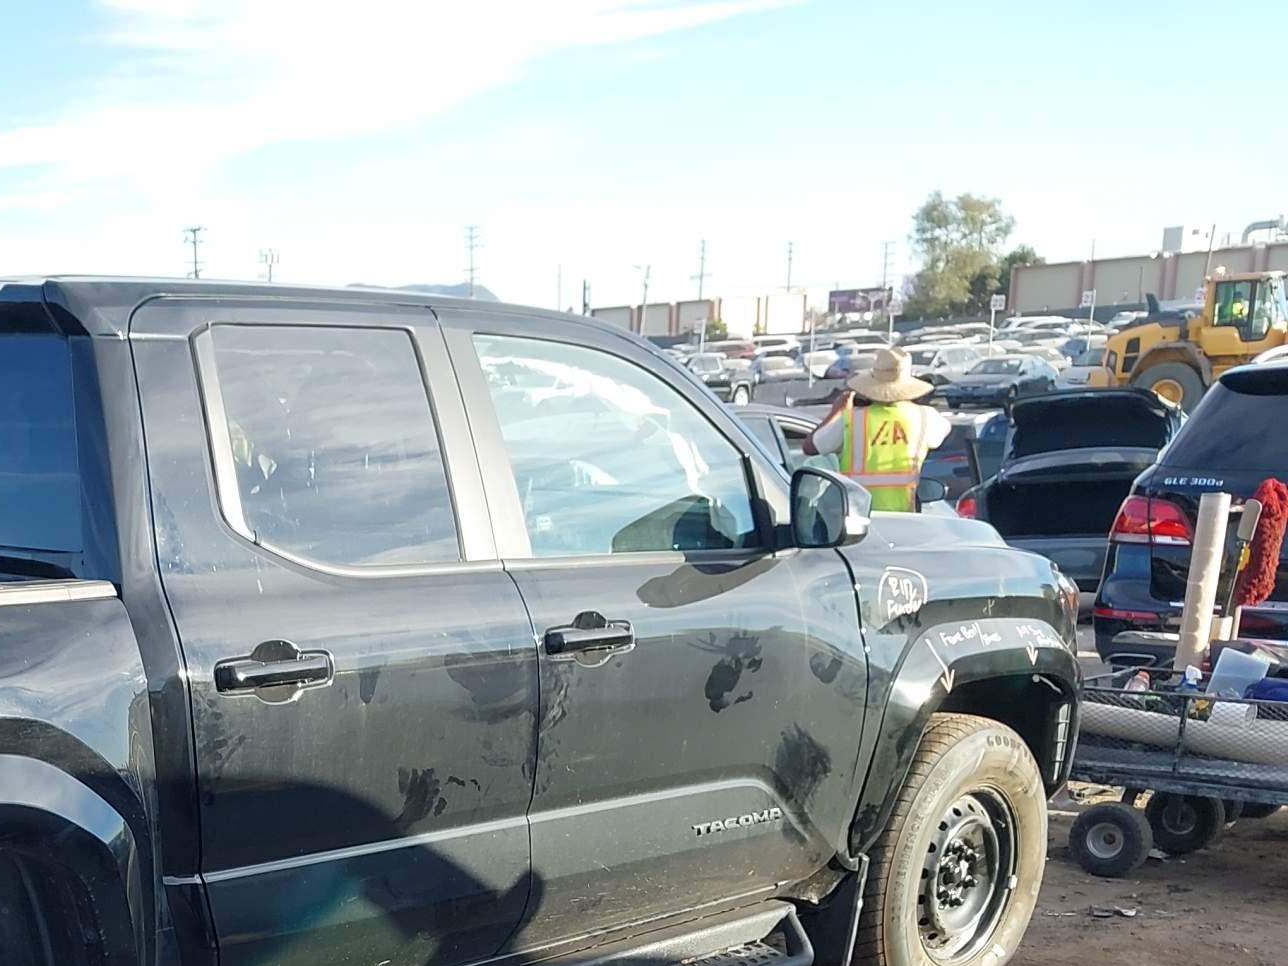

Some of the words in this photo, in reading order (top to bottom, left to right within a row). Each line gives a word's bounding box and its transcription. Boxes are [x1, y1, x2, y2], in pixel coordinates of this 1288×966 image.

[1164, 477, 1188, 485] GLE
[1190, 477, 1224, 486] 300d
[692, 807, 784, 837] TACOMA
